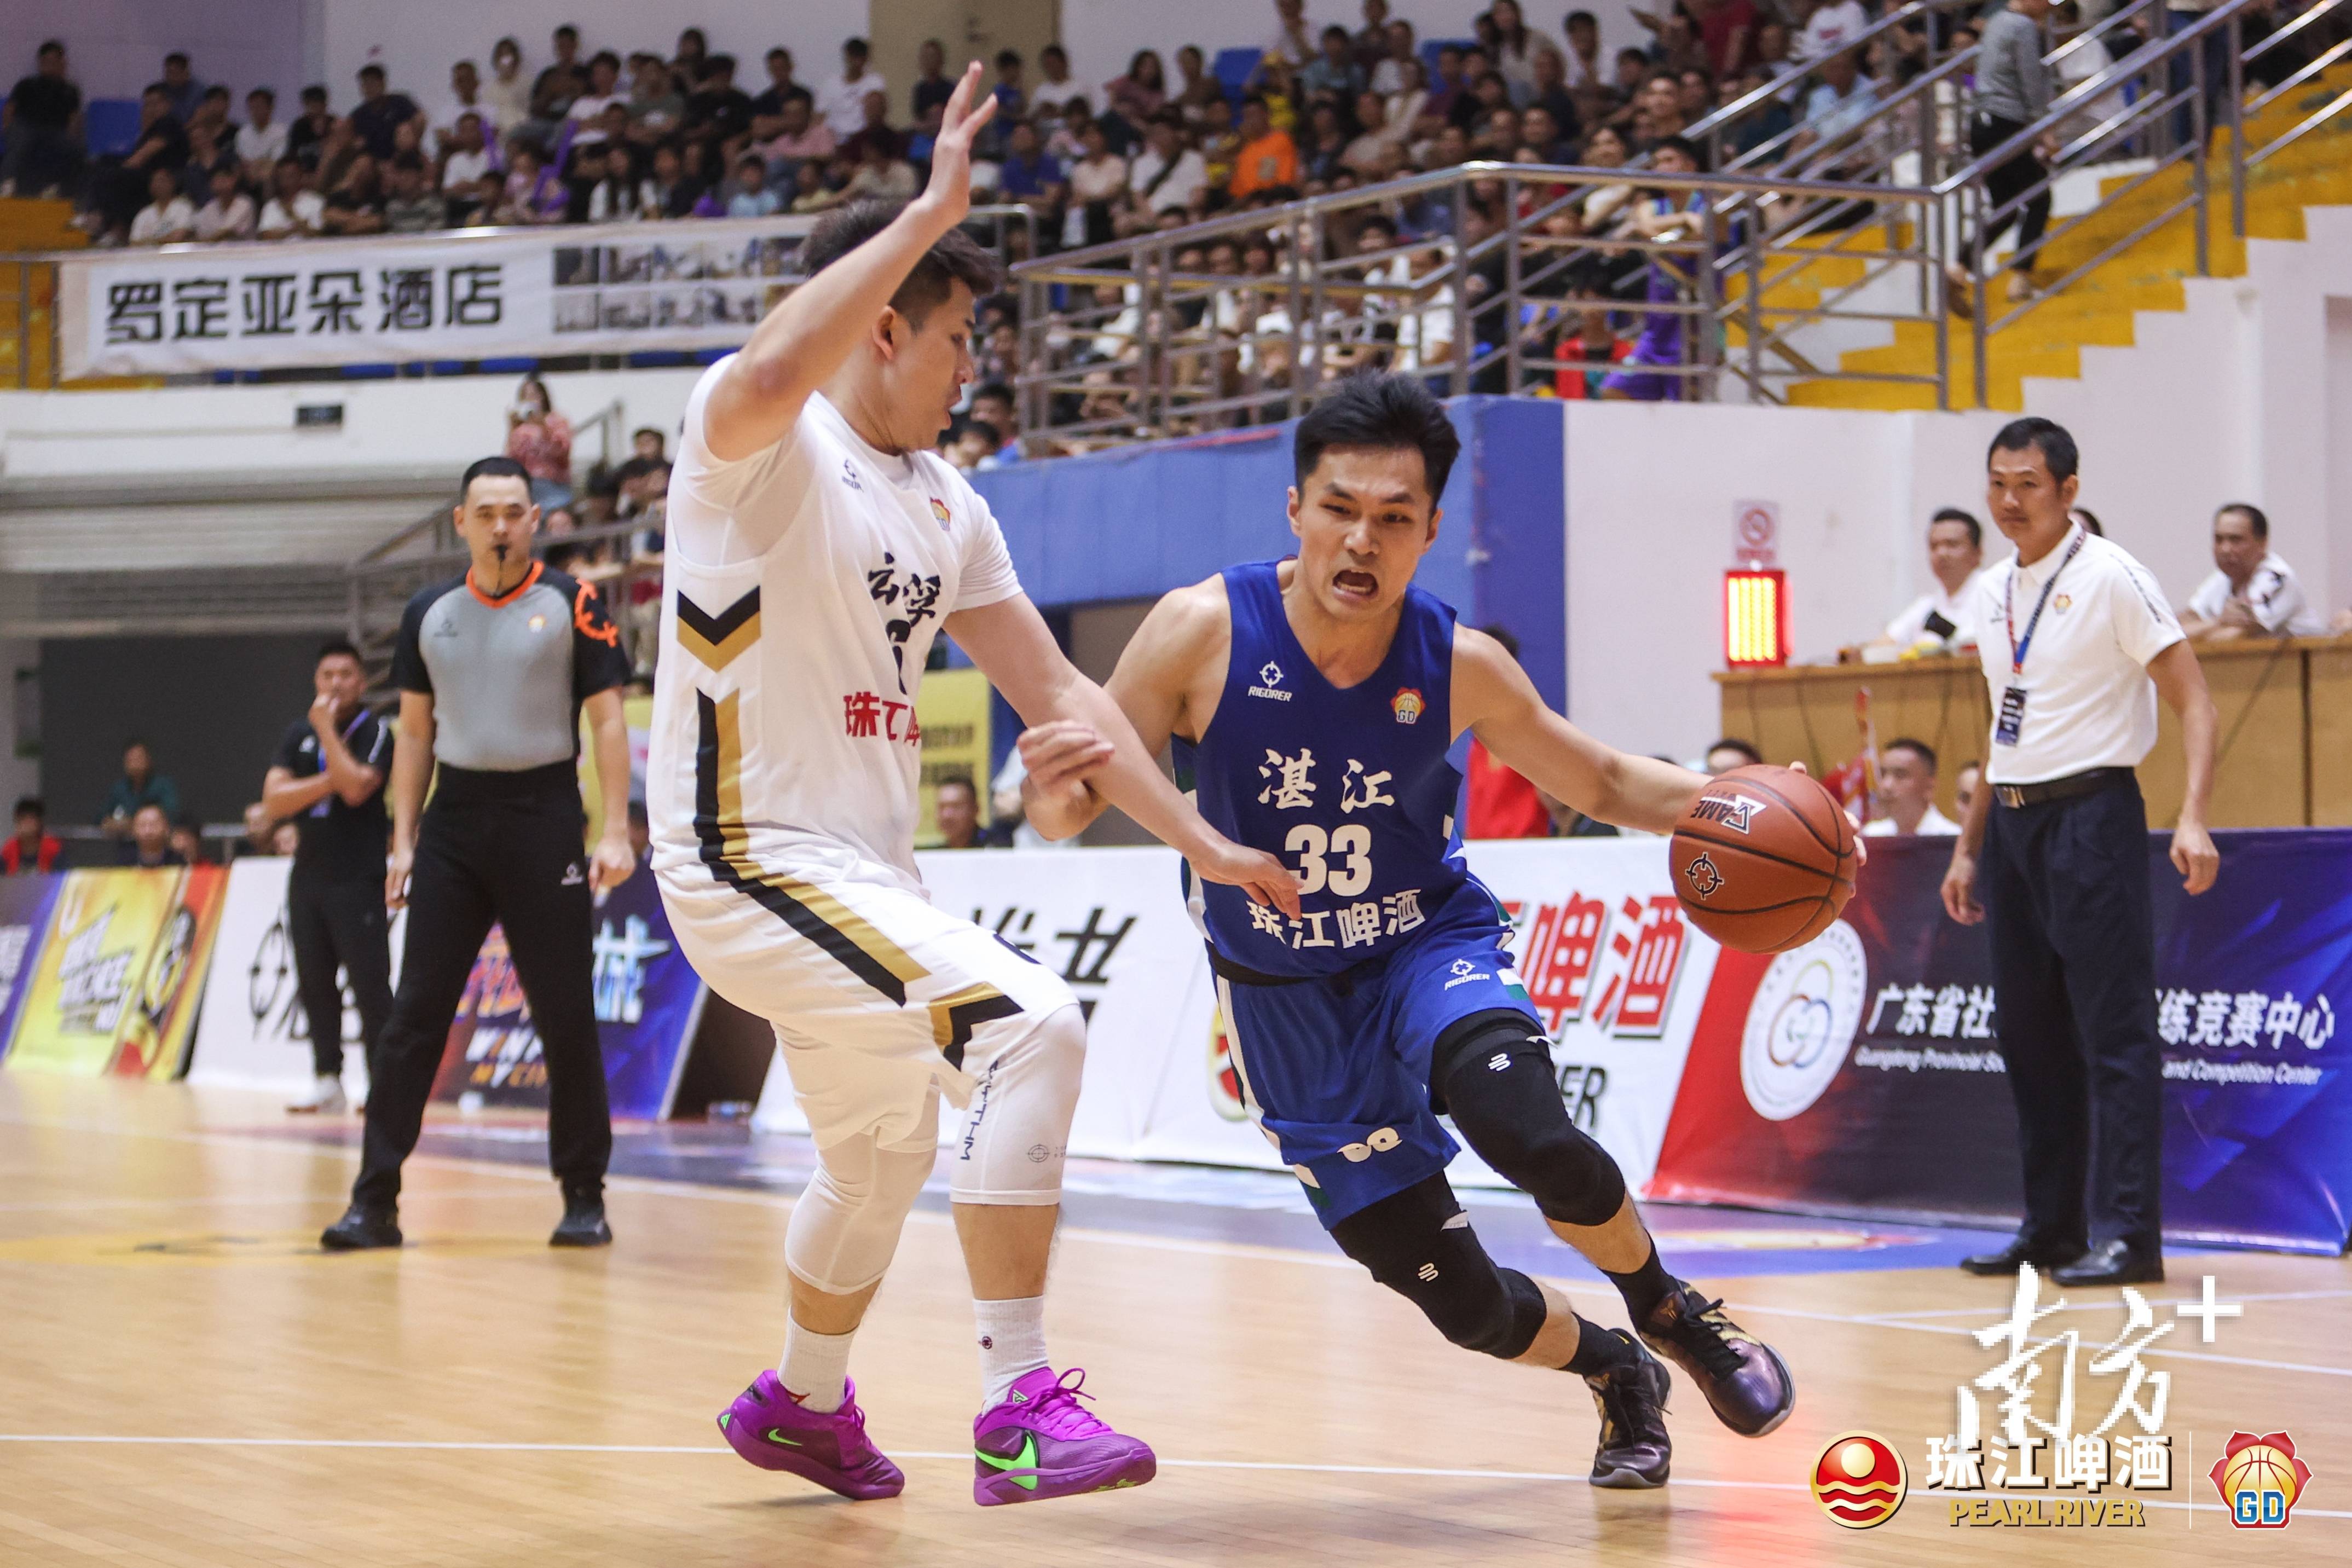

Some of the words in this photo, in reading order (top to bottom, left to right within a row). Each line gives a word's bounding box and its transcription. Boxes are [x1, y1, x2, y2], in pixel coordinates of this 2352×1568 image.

[106, 264, 503, 345] 罗定亚朵酒店
[1247, 685, 1292, 702] RIGORER
[1397, 709, 1417, 724] GD
[1257, 748, 1395, 814] 湛江
[1284, 824, 1372, 896] 33
[1246, 888, 1425, 950] 珠江啤酒
[1444, 973, 1490, 991] RIGORER
[1501, 889, 1690, 1039] 啤酒
[1866, 982, 1997, 1039] 广东省社
[2154, 988, 2336, 1050] 练竞赛中心
